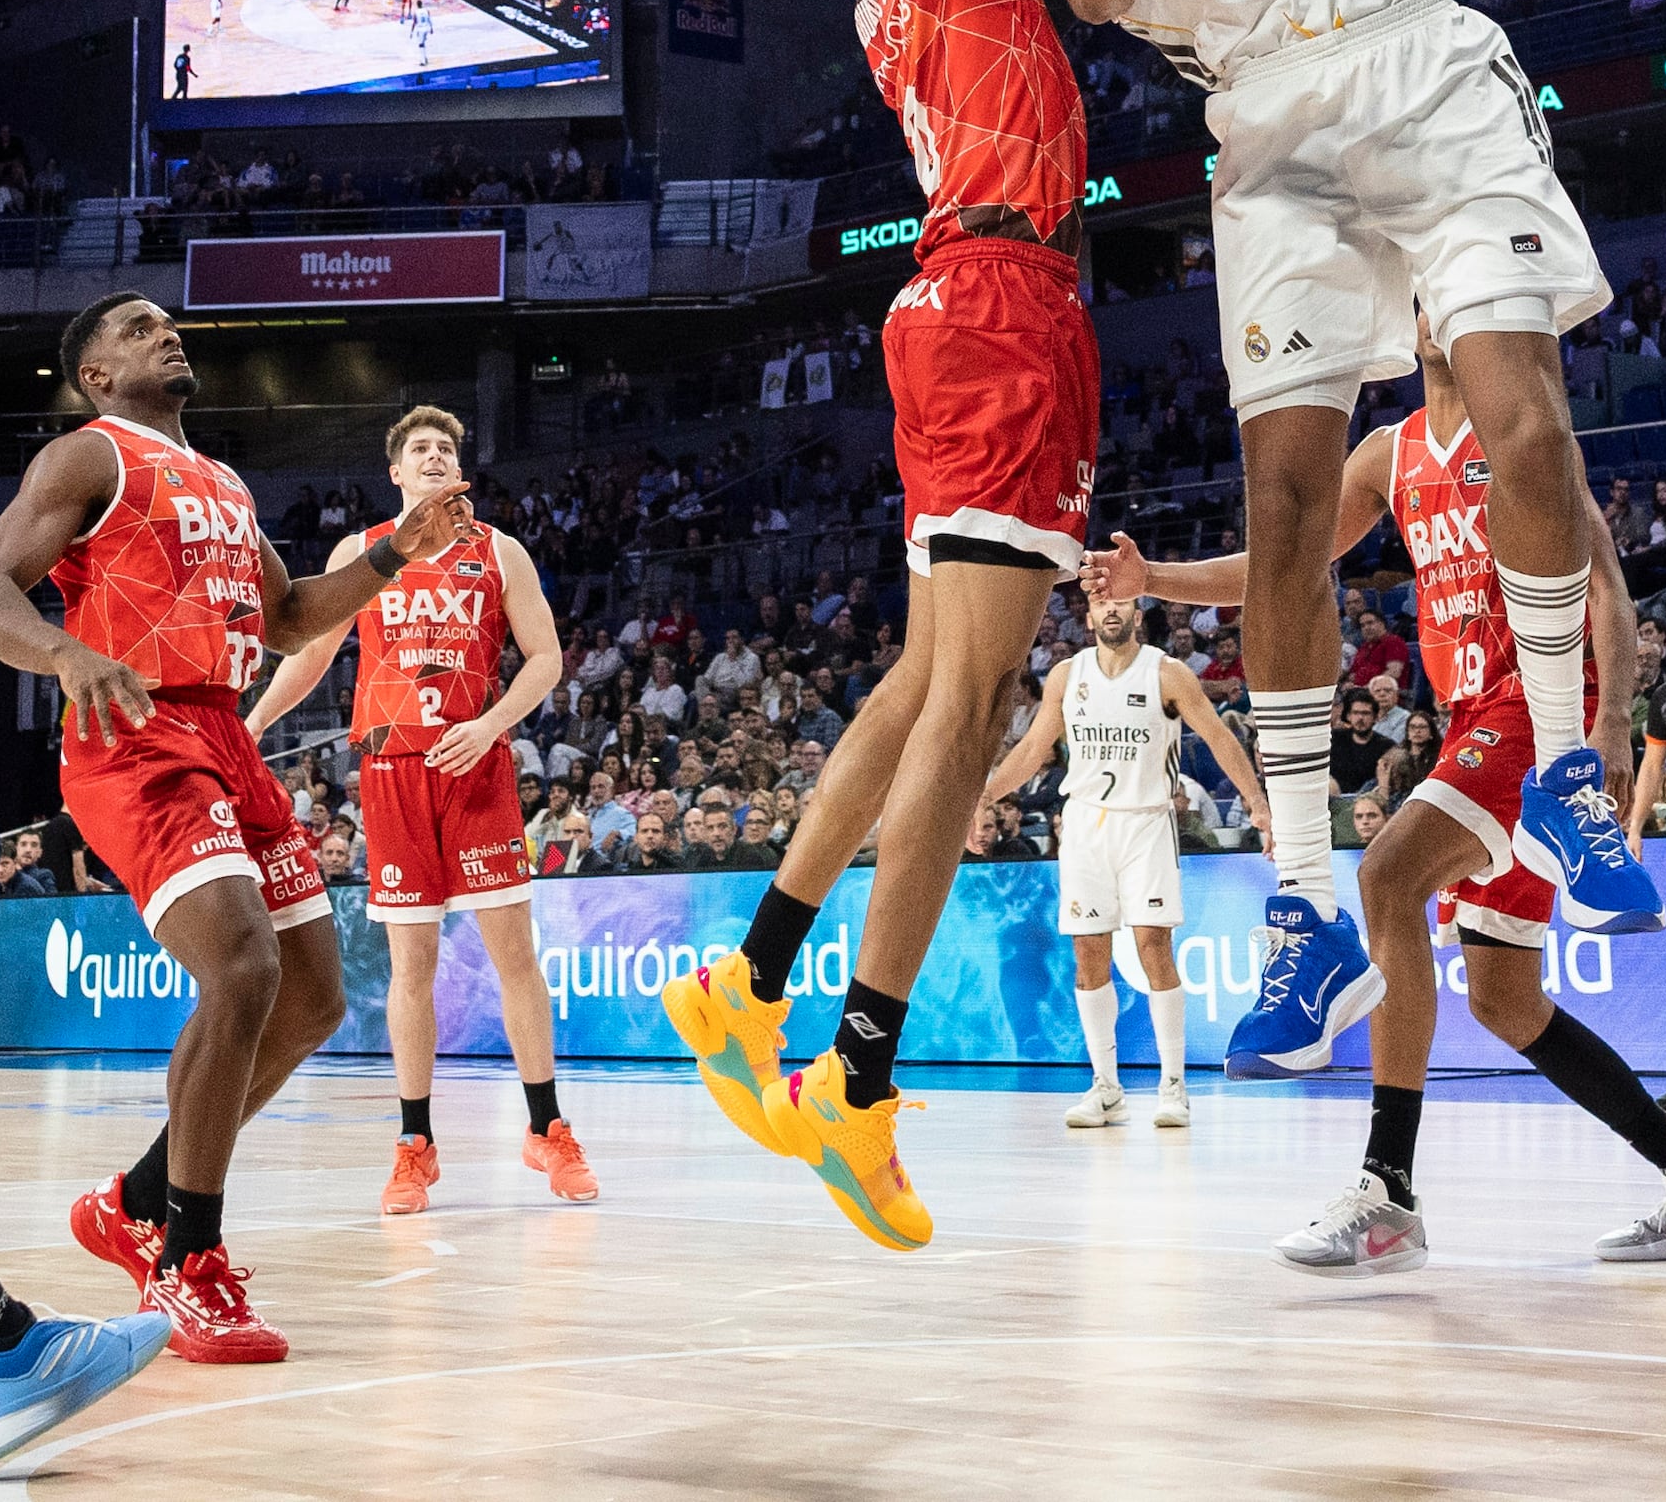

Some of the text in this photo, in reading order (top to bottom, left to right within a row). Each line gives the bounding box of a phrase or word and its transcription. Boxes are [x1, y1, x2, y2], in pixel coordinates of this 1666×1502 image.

[840, 216, 924, 256] SKOD
[1514, 241, 1537, 252] acb
[300, 250, 392, 276] Mahou
[1407, 503, 1489, 571] BAX
[378, 587, 485, 627] BAXI
[398, 648, 466, 670] MANRESA
[418, 686, 447, 727] 2
[1071, 722, 1150, 745] Emirates
[1100, 745, 1138, 761] BETTER
[1100, 771, 1116, 801] 7
[458, 842, 507, 862] Adbisio
[267, 855, 304, 884] ETL
[461, 859, 489, 876] ETL
[466, 871, 513, 889] GLOBAL
[273, 869, 323, 900] GLOBA
[81, 941, 197, 1017] quirón
[543, 923, 849, 1019] quirónud
